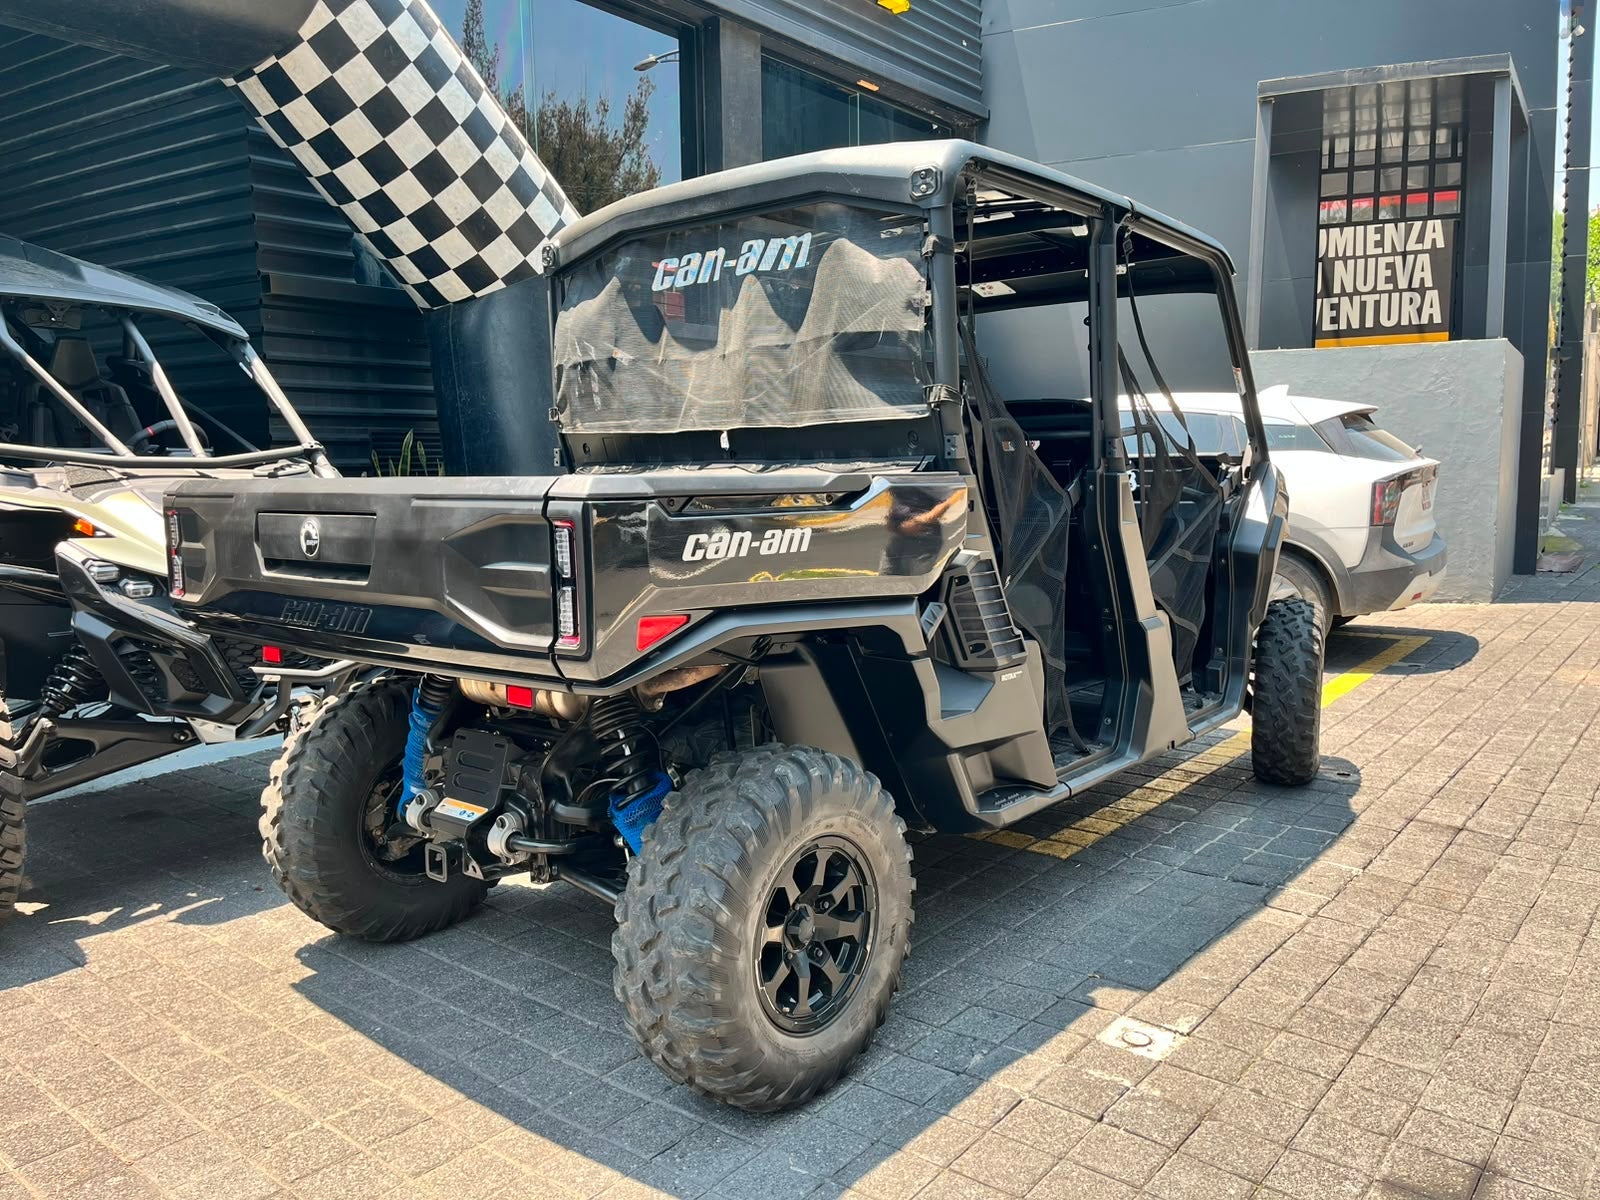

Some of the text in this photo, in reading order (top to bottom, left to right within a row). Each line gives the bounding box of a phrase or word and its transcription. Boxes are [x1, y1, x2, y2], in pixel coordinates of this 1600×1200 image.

[651, 231, 812, 292] can-am
[1333, 253, 1434, 294] NUEVA
[1315, 289, 1442, 331] ENTURA
[681, 527, 813, 562] can-am
[279, 599, 373, 634] can-am
